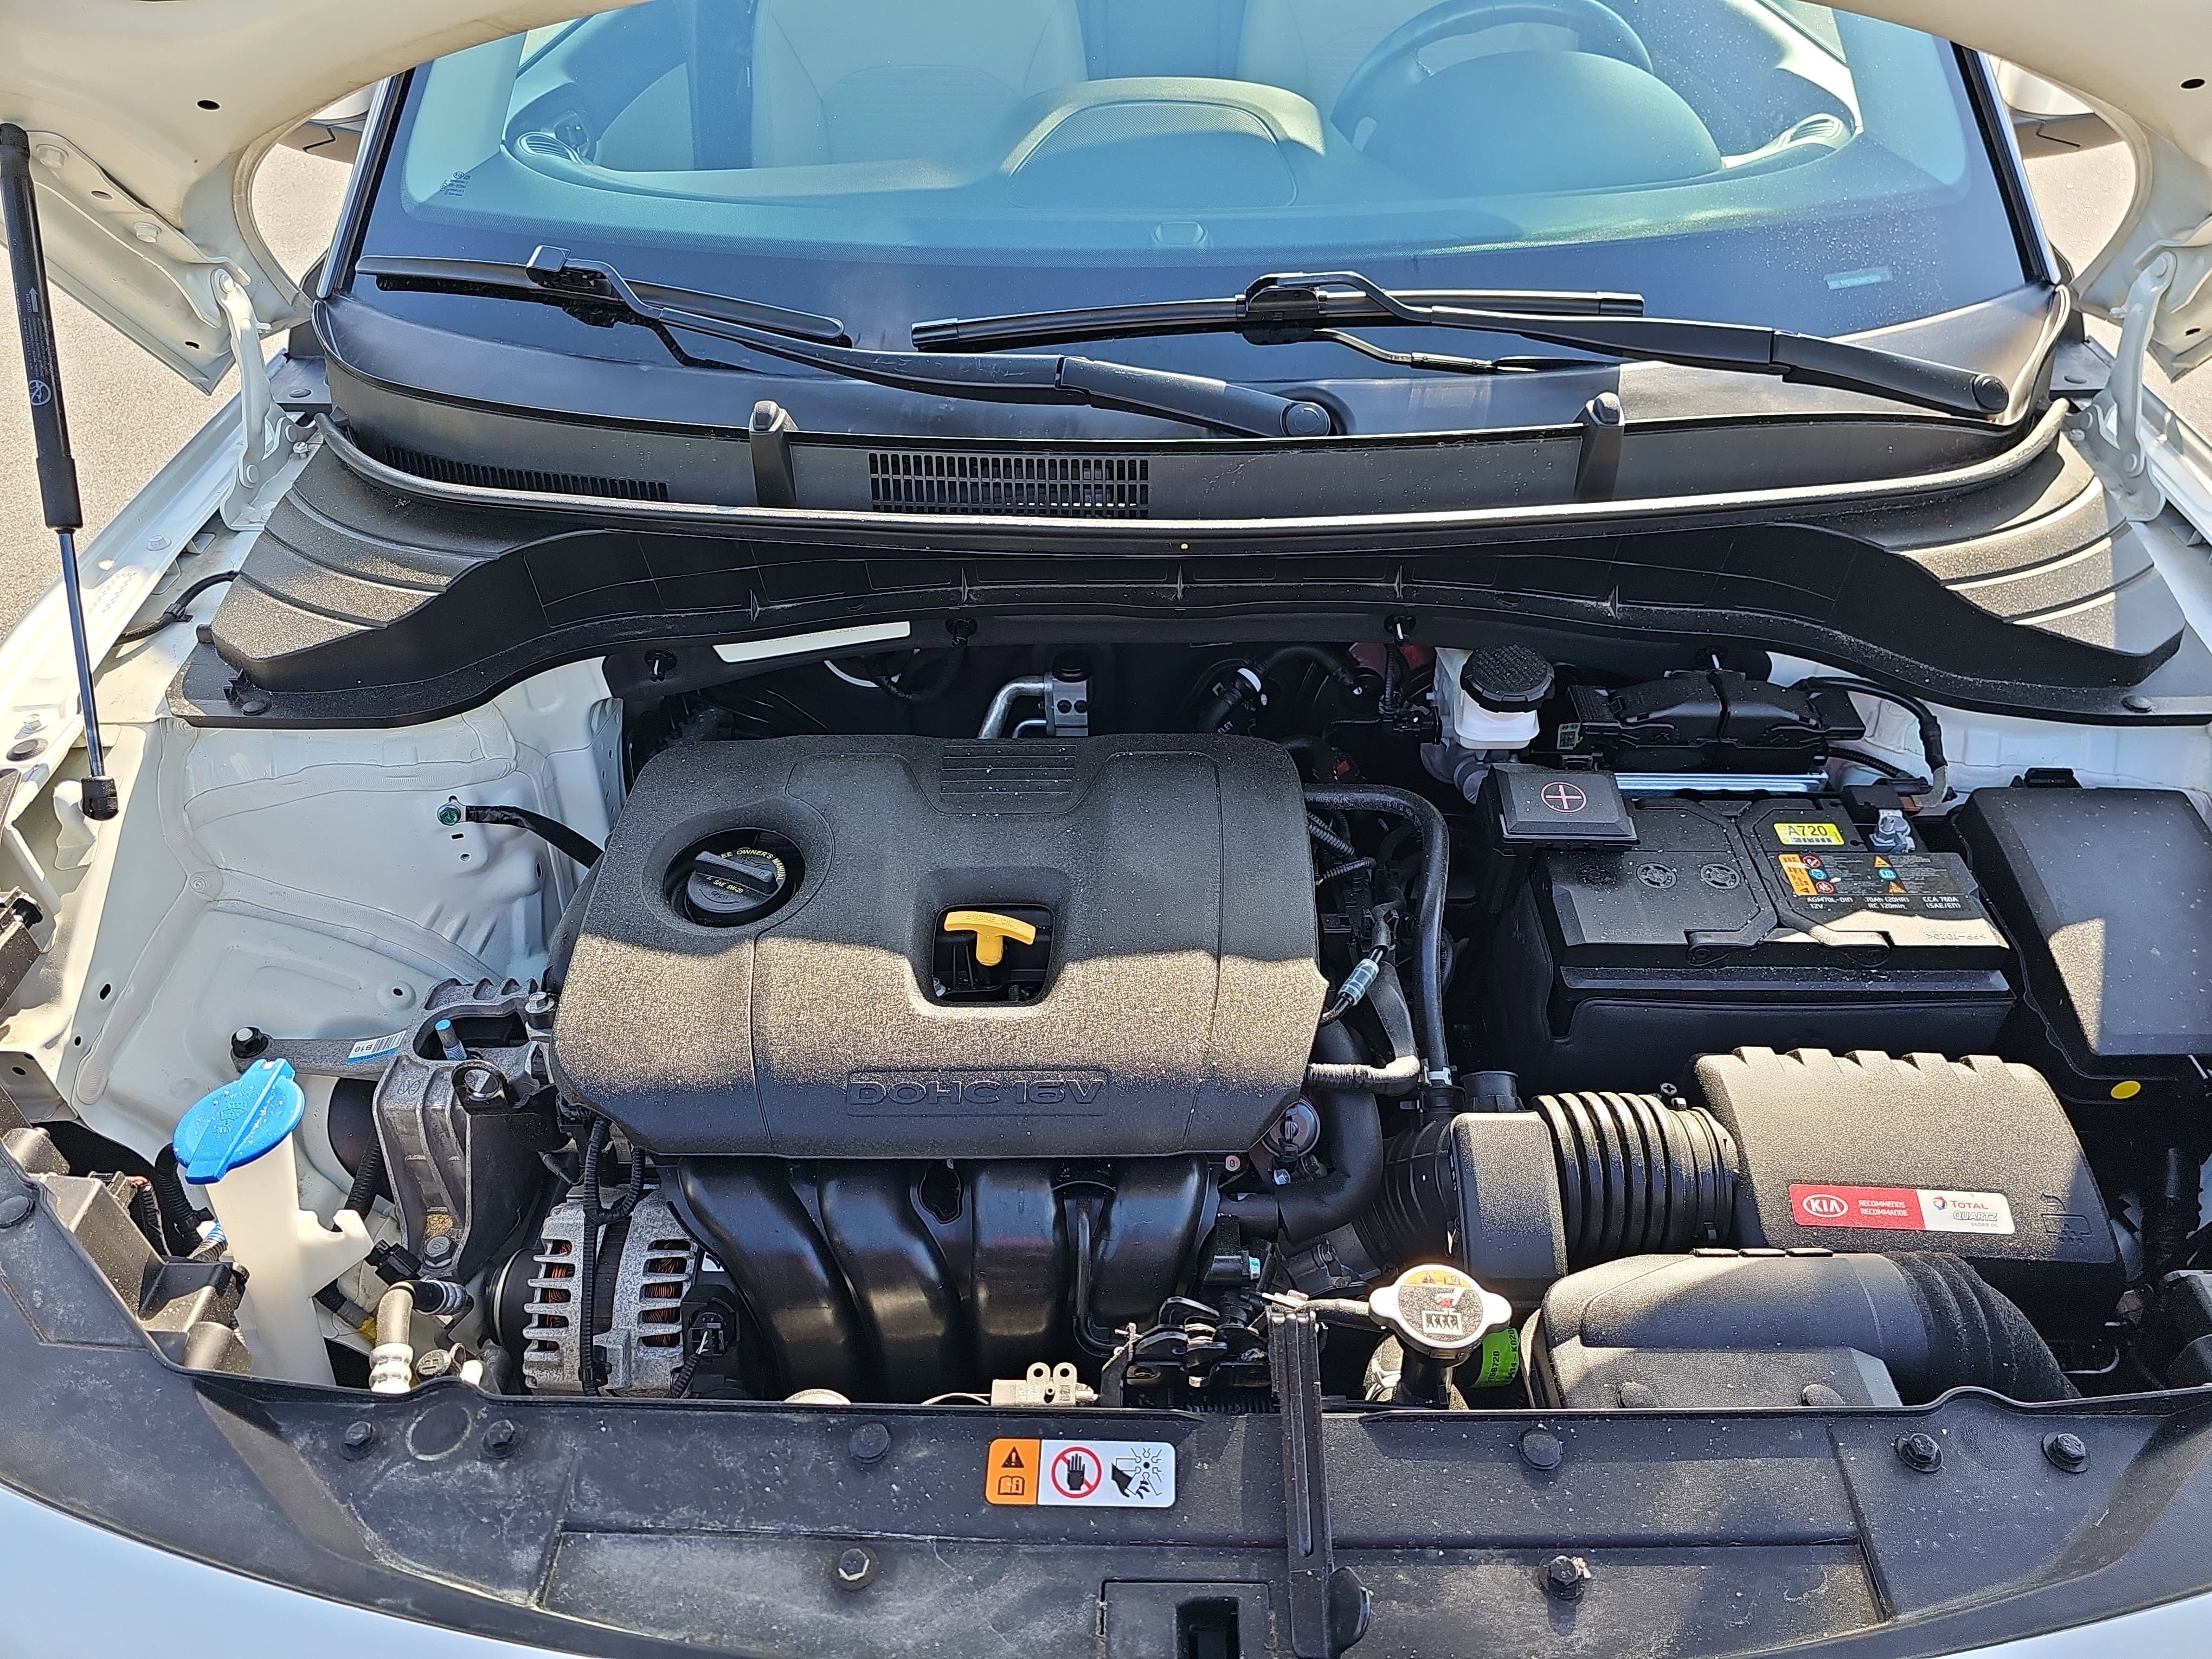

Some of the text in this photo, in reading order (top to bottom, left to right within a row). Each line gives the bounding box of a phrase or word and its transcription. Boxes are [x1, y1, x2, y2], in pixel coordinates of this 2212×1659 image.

[1787, 825, 1828, 837] A720
[736, 850, 774, 859] OWNER'S
[771, 858, 786, 880] MANUAL
[726, 884, 744, 893] 5W-20
[966, 914, 996, 922] ENGINE
[354, 1044, 374, 1053] B10
[850, 1079, 1106, 1105] DOHC 16V
[1809, 1199, 1842, 1213] KIA
[1858, 1199, 1906, 1208] RECOMMENDS
[1949, 1200, 1989, 1210] TOTAL
[1860, 1208, 1908, 1217] RECOMMANDE
[1953, 1210, 1998, 1221] QUARTZ
